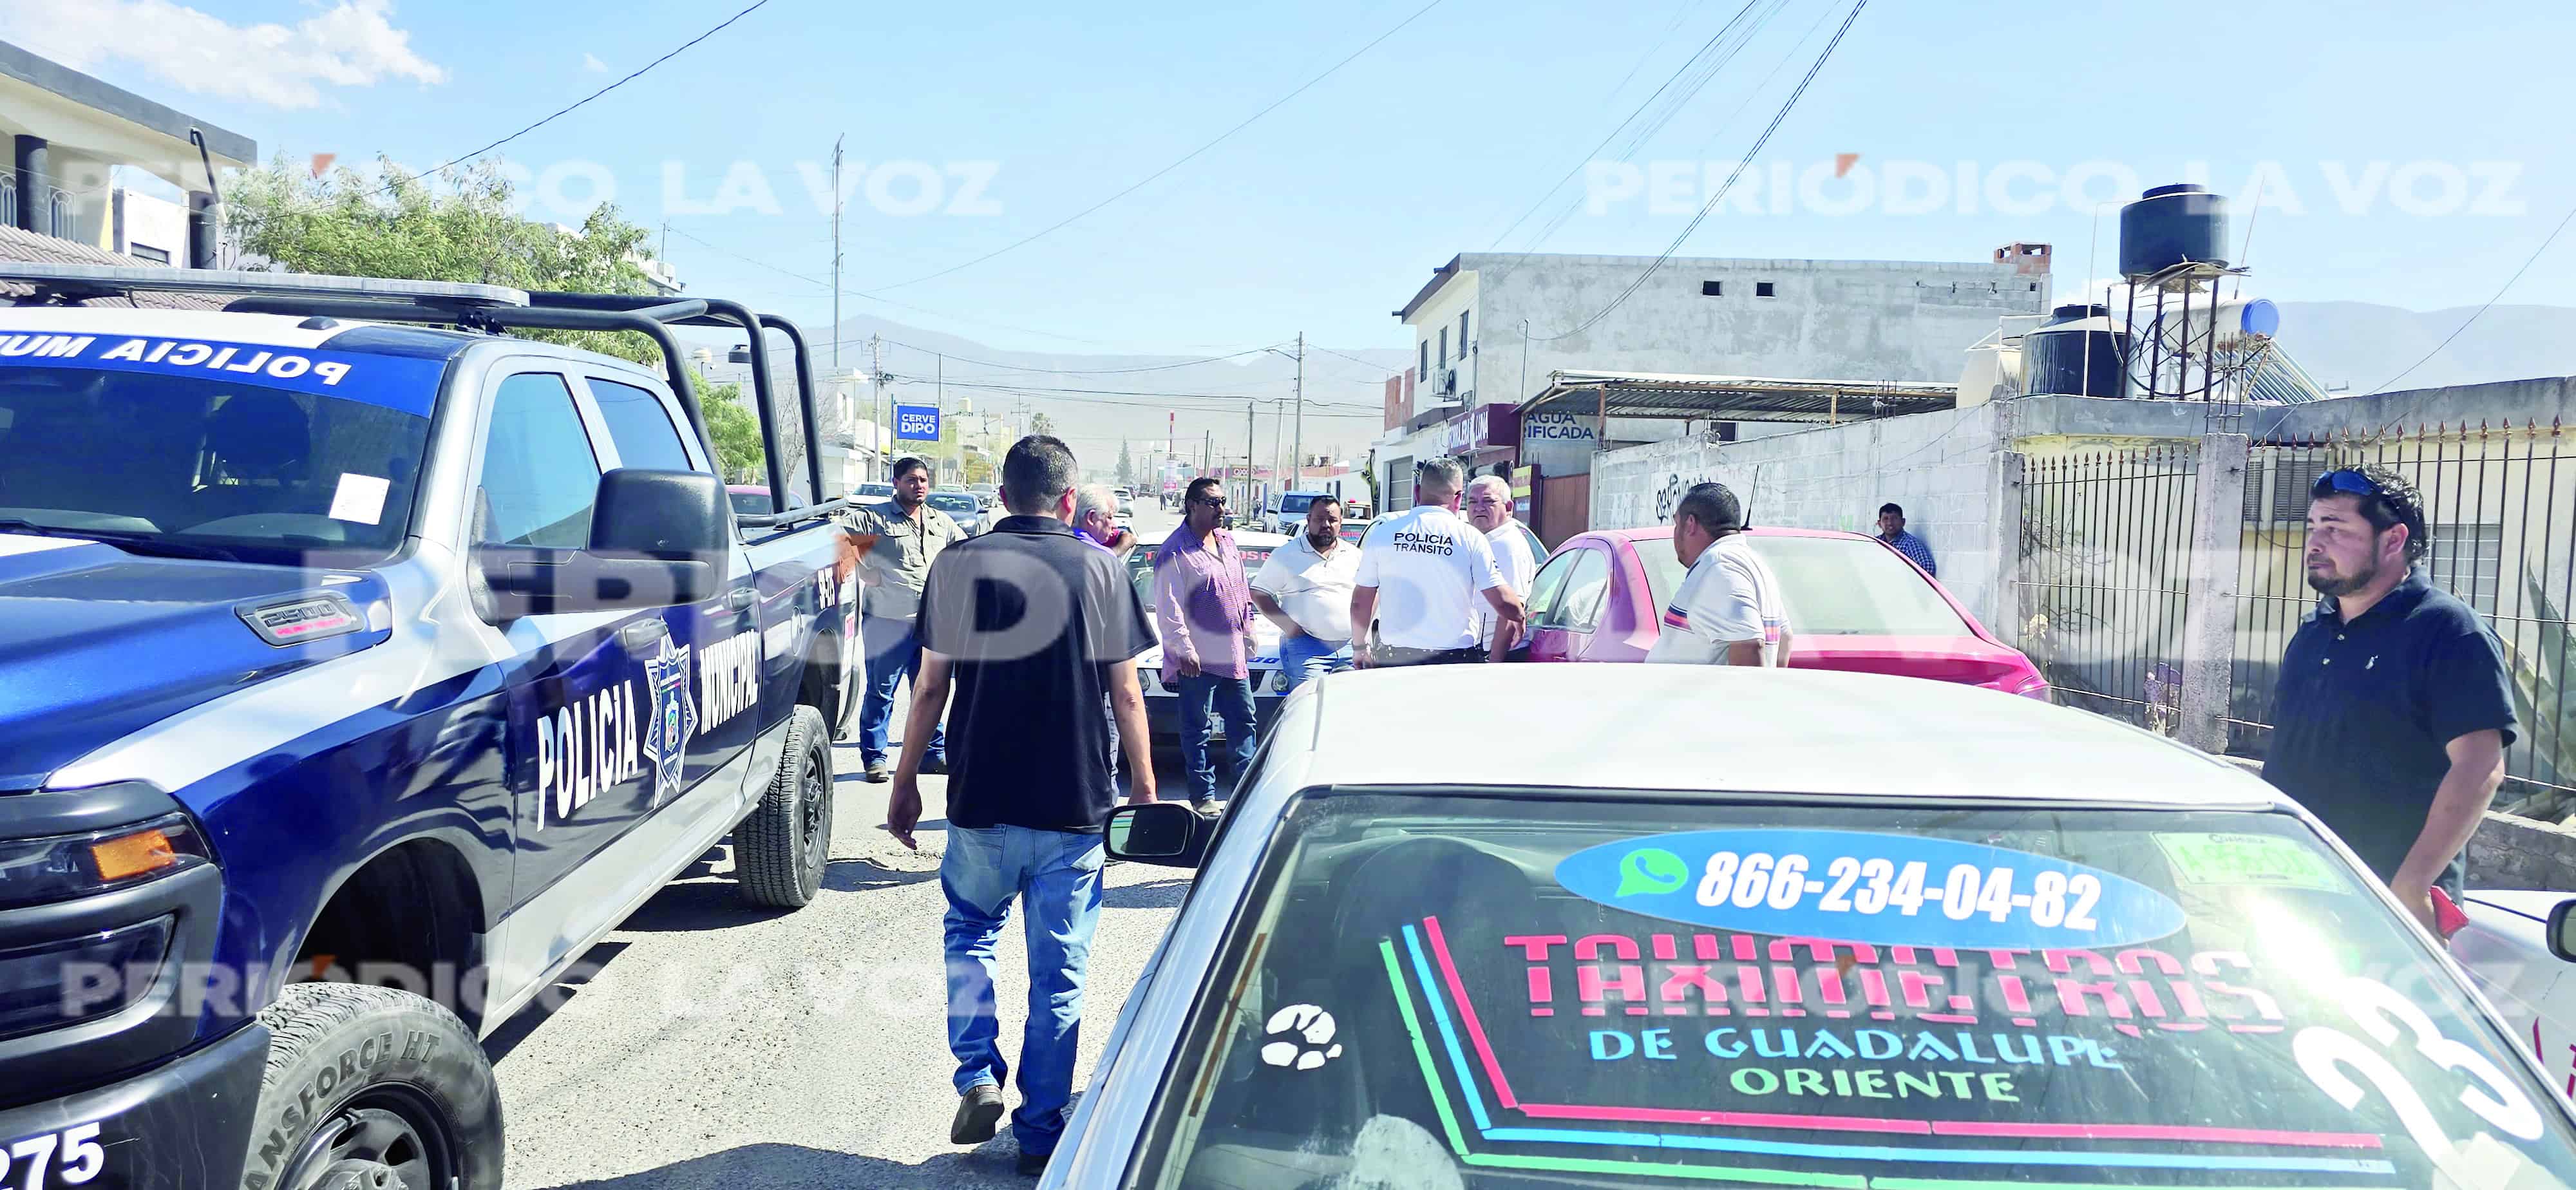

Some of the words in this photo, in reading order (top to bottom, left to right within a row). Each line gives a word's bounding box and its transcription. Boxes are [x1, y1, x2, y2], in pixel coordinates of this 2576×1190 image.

[901, 422, 936, 434] DIPO
[902, 413, 936, 423] CERVE
[1525, 412, 1577, 424] AGUA
[1394, 542, 1453, 556] TRÁNSITO
[261, 603, 336, 628] 2500
[699, 628, 759, 735] MUNICIPAL
[1696, 851, 2101, 931] 866-234-04-82
[401, 1030, 440, 1062] HT
[1589, 1028, 1677, 1060] DE
[1730, 1068, 2020, 1102] ORIENTE
